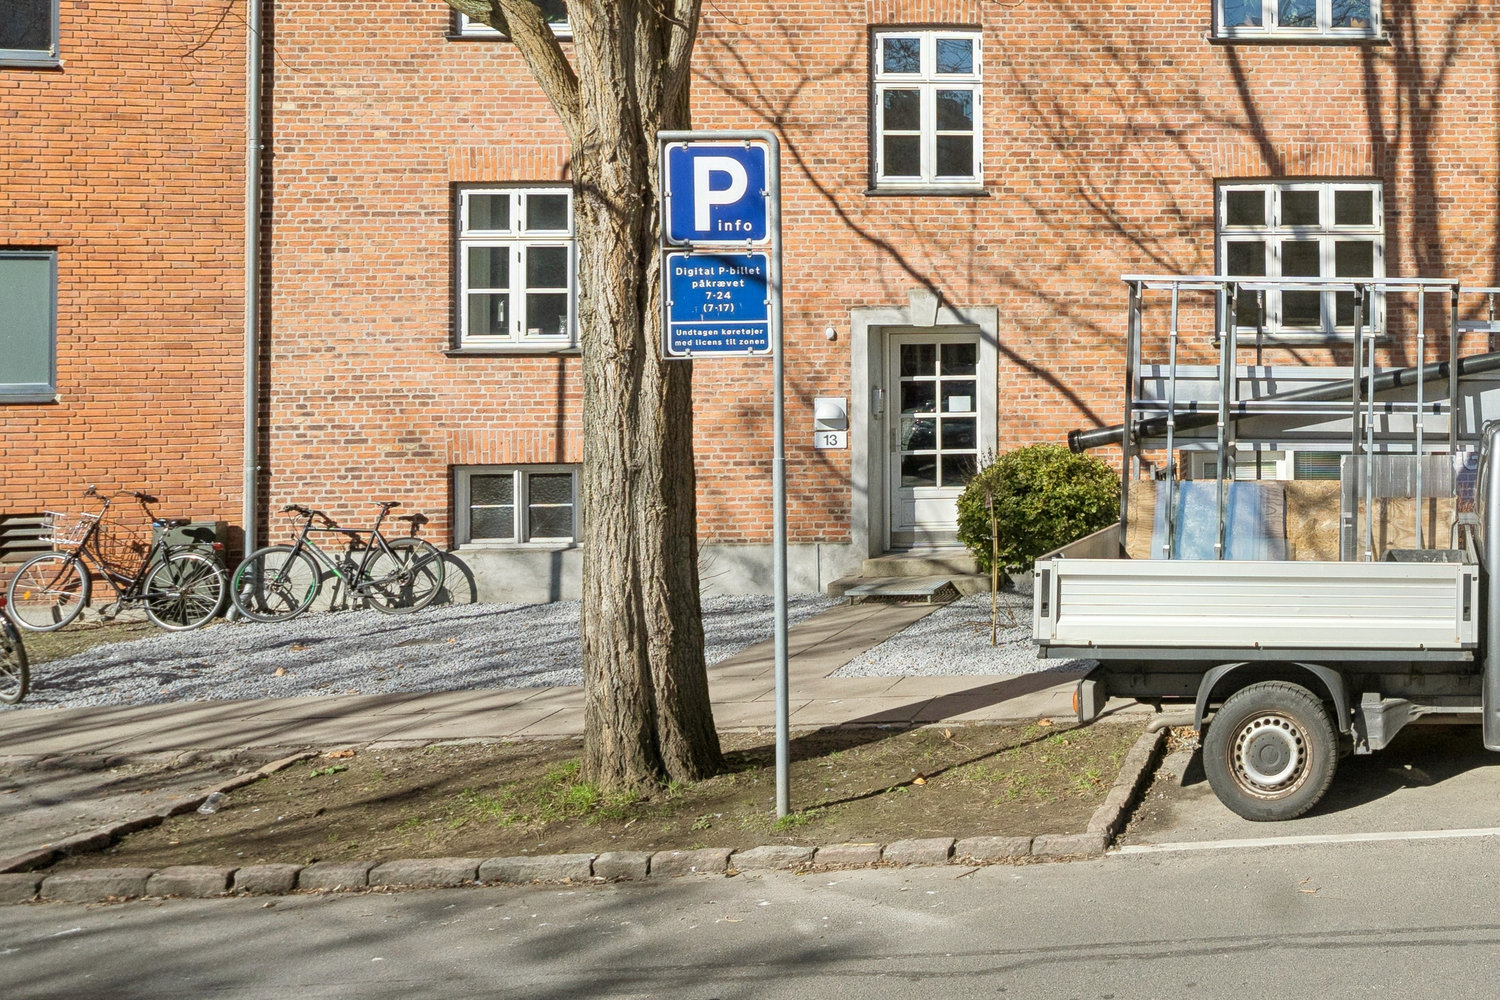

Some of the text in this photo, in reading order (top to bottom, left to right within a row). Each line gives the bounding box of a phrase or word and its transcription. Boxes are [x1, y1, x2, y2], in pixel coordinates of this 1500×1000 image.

[694, 156, 748, 231] P
[718, 219, 752, 231] info
[675, 266, 760, 277] Digital P-billet
[692, 279, 744, 289] påkrævet
[705, 291, 731, 300] 7-24
[703, 303, 734, 313] (7-17)
[721, 328, 764, 336] køretøjer
[823, 434, 838, 446] 13
